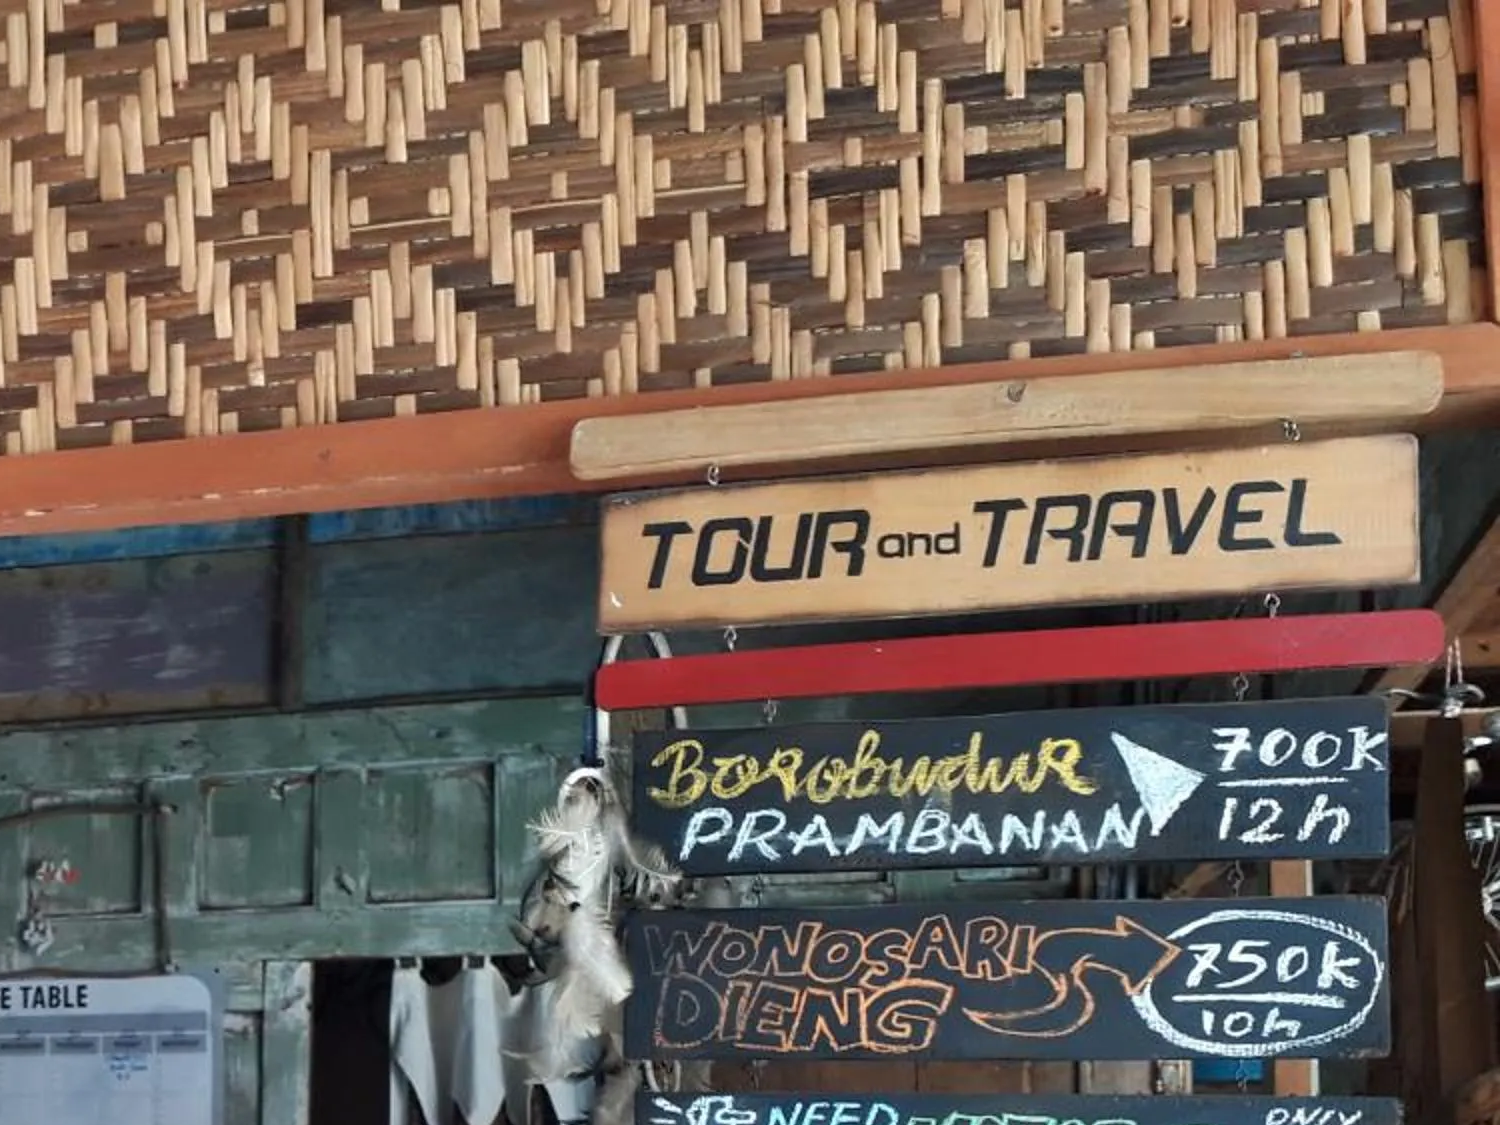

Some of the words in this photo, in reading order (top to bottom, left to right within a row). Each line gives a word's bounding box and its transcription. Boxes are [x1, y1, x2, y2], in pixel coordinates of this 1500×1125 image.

[642, 509, 870, 589] TOUR
[877, 521, 960, 558] and
[973, 478, 1342, 567] TRAVEL
[679, 803, 1148, 862] PRAMBANAN
[644, 914, 1035, 990] WONOSARI
[20, 984, 88, 1009] TABLE
[654, 976, 954, 1052] DIENG
